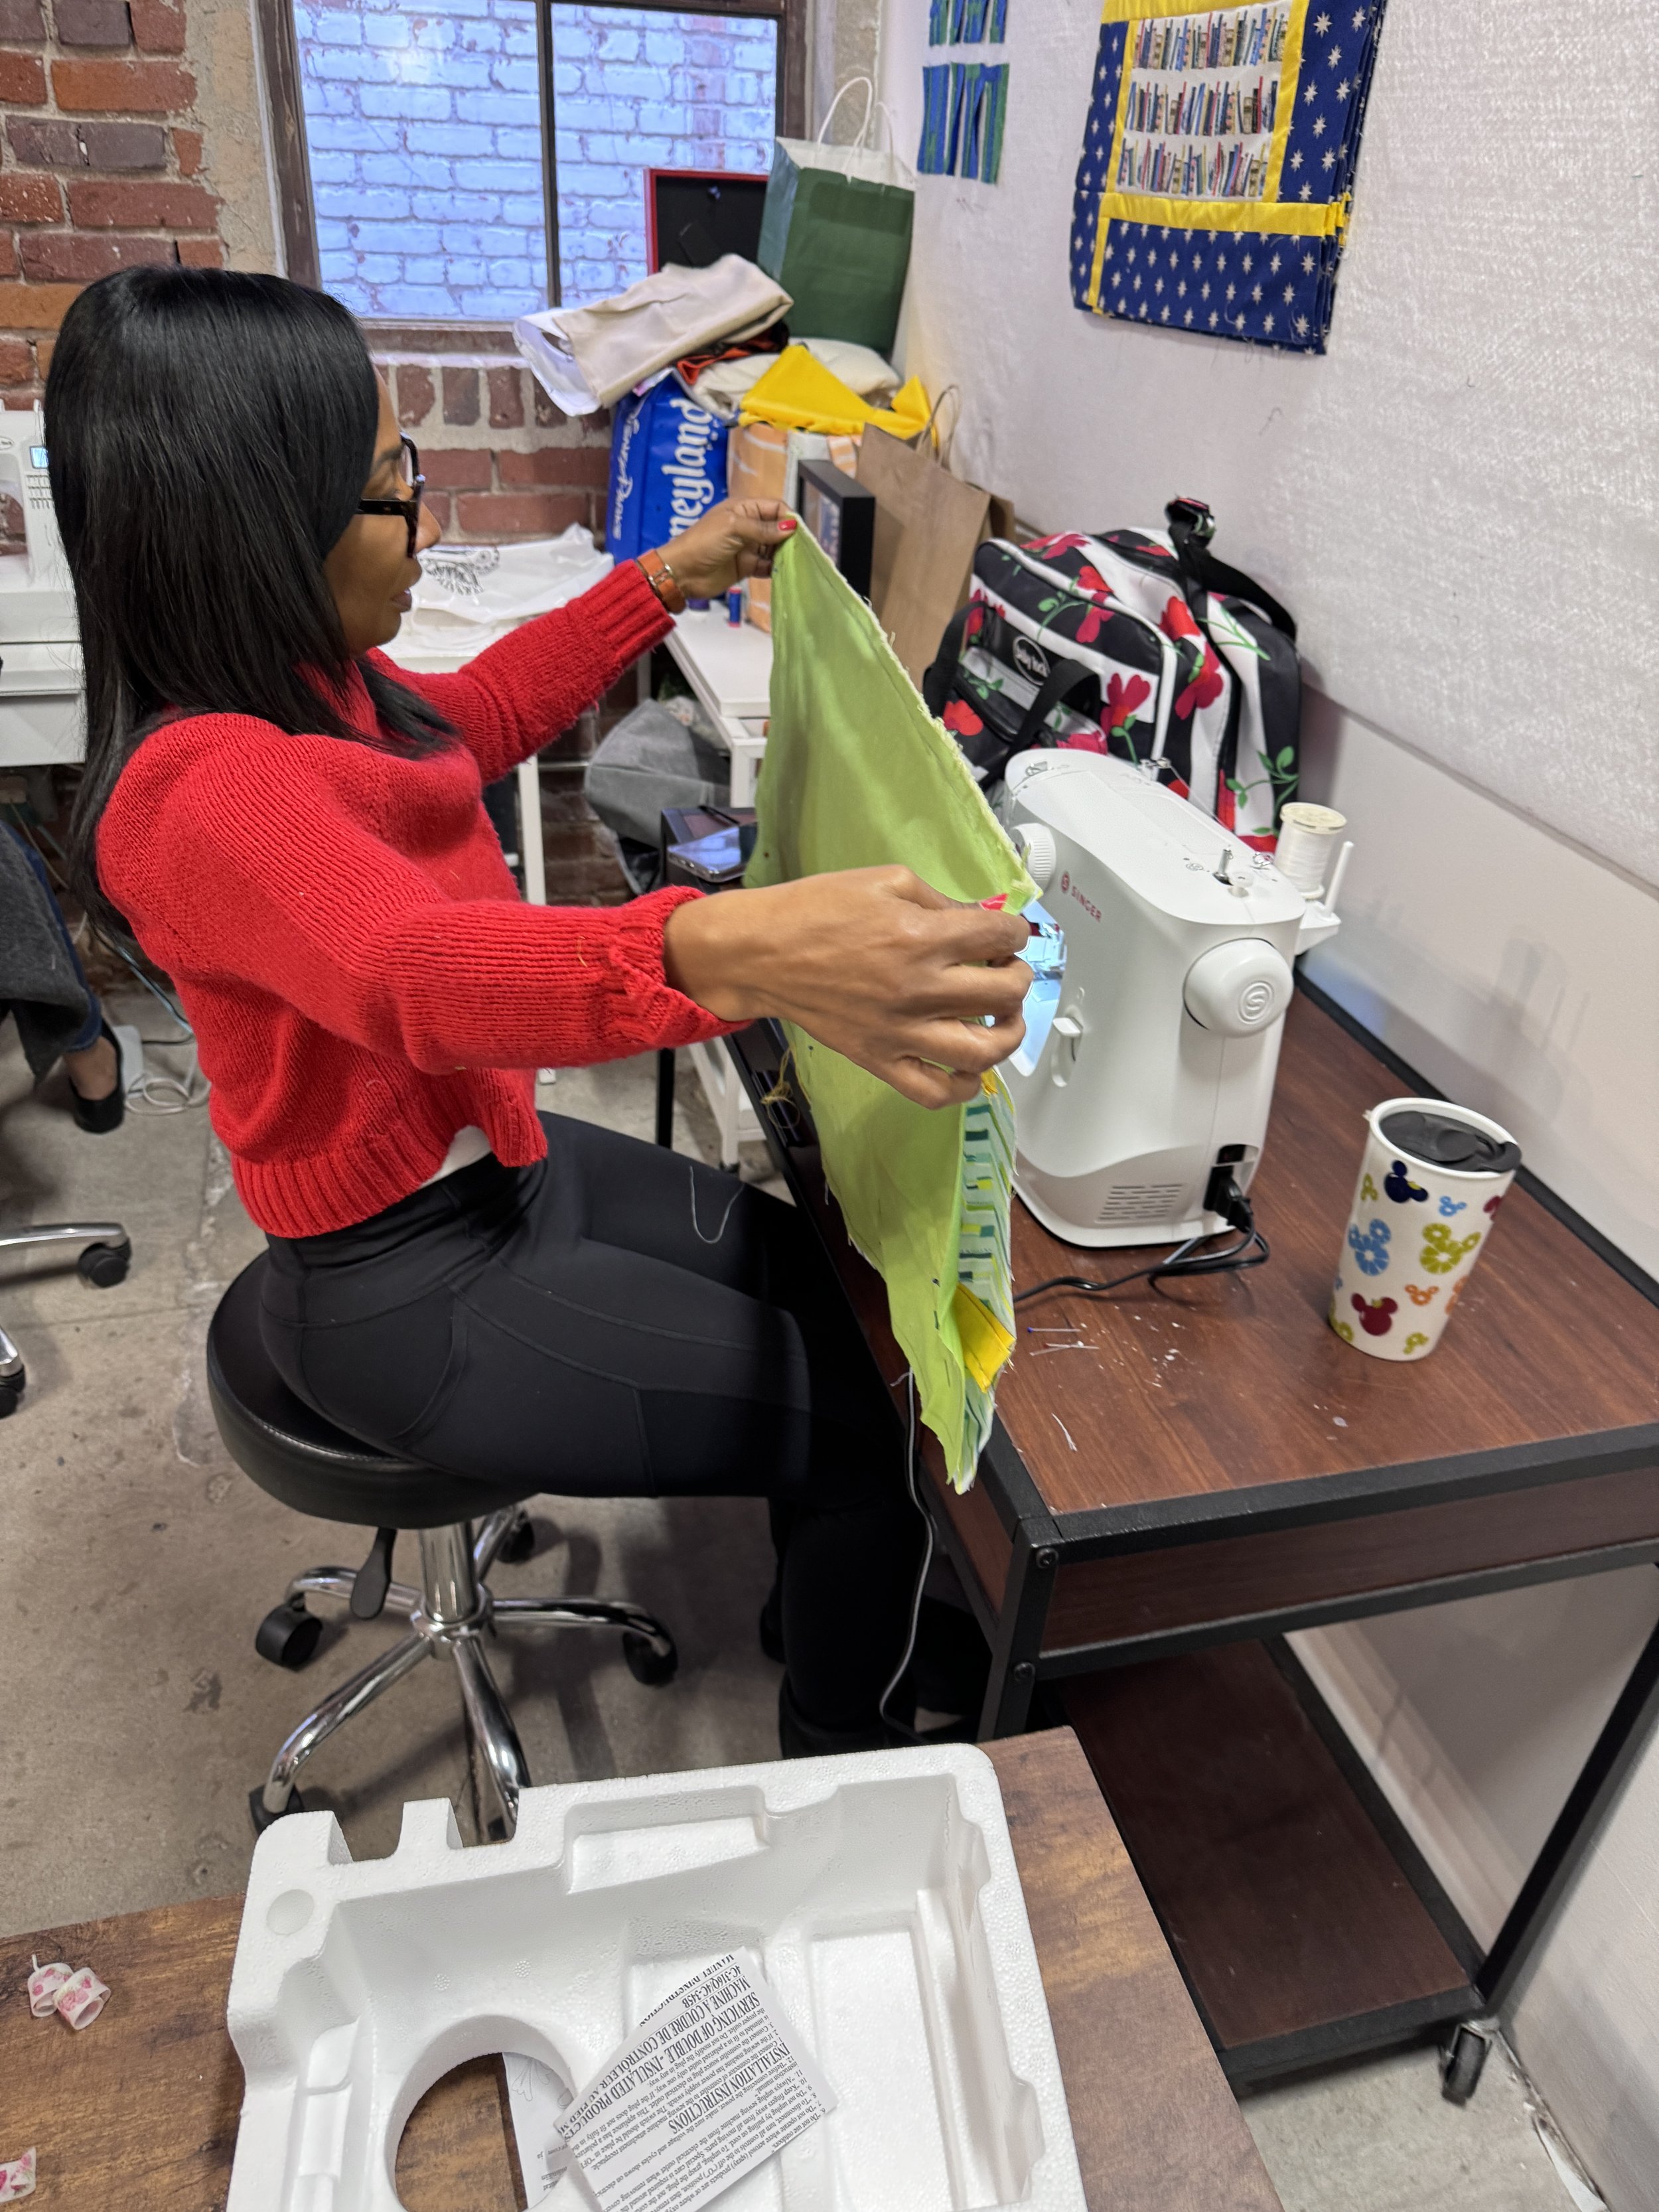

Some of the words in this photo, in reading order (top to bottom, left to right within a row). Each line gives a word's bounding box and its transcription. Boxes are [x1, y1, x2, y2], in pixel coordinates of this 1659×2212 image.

[1071, 885, 1102, 924] SINGER
[682, 1965, 741, 2009] 4C-316Q/4C-345B
[709, 1975, 751, 2010] MACHINE
[668, 2004, 705, 2037] COUDRE
[701, 1999, 715, 2018] À
[711, 1992, 760, 2032] SERVICING
[655, 2026, 672, 2045] DE
[664, 2029, 704, 2064] DOUBLE
[700, 2022, 715, 2041] OF
[599, 2036, 658, 2089] CONTRÔLEUR
[729, 2042, 791, 2093] INSTALLATION
[589, 2087, 599, 2103] AU
[668, 2081, 733, 2134] INSTRUCTIONS
[569, 2102, 589, 2124] PIED
